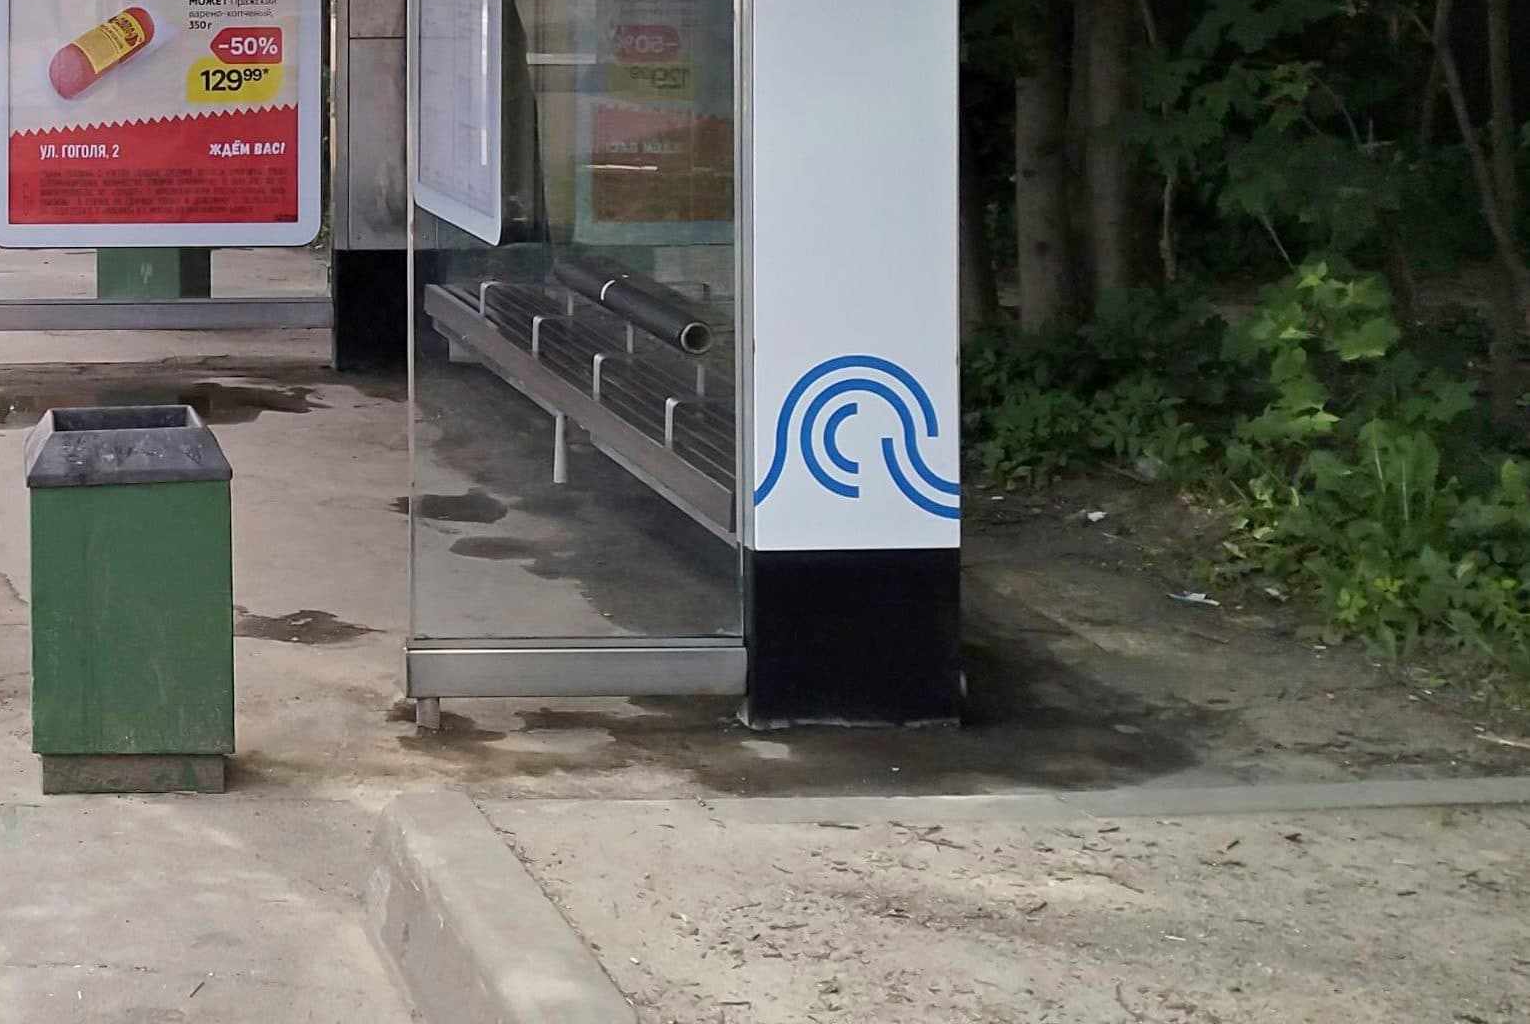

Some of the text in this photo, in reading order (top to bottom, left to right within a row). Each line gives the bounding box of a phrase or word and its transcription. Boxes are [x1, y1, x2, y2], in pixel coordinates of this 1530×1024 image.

[218, 36, 278, 55] -50%
[39, 144, 120, 160] УЛ. ГОГОЛЯ, 2
[209, 140, 285, 156] ЖДЁМ ВАС!
